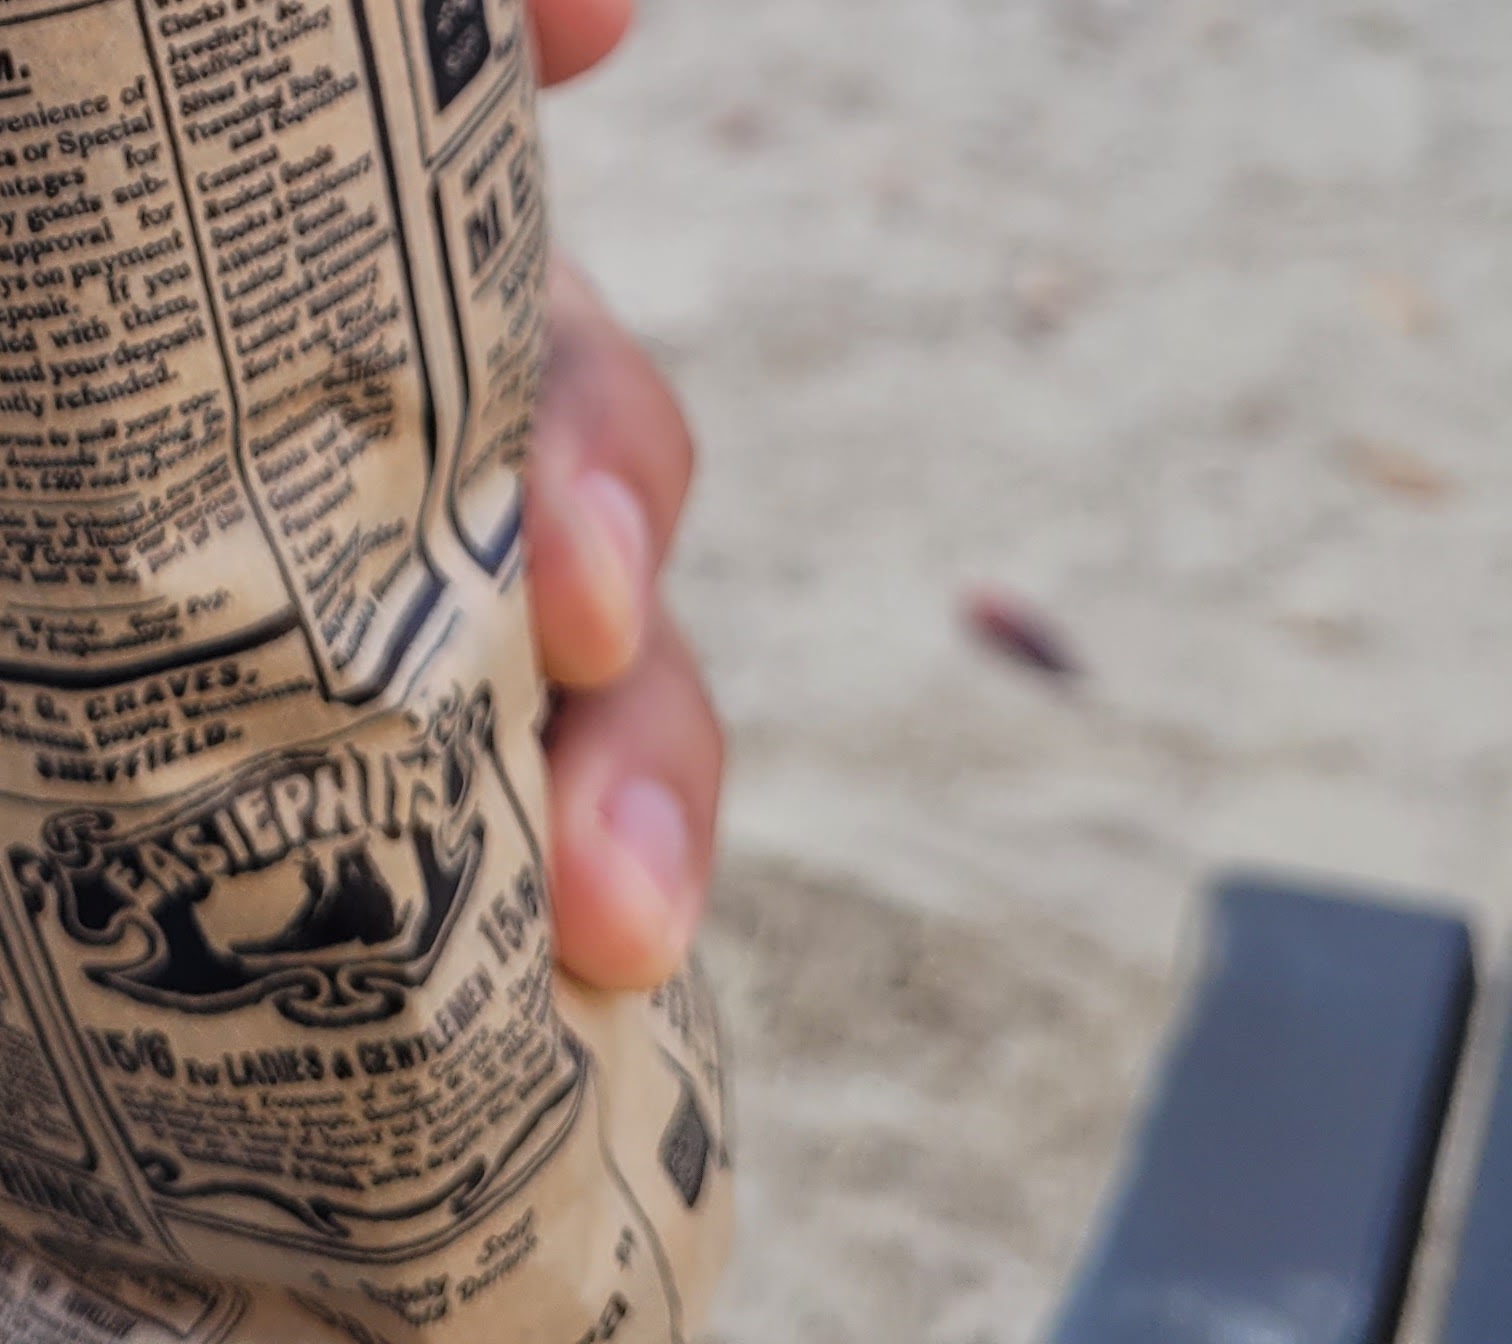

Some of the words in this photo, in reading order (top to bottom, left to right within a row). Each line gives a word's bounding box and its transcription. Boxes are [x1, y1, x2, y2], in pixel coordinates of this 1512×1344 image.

[120, 75, 147, 105] of
[24, 142, 49, 164] or
[58, 107, 154, 159] Special
[125, 142, 159, 170] for
[26, 194, 102, 233] goods
[138, 203, 175, 231] for
[33, 269, 64, 287] on
[71, 231, 185, 287] payment
[106, 276, 130, 305] If
[144, 262, 191, 295] you
[0, 360, 45, 383] and
[51, 353, 109, 386] your
[115, 316, 207, 364] deposit
[51, 317, 110, 350] with
[224, 1038, 324, 1088] LADIES
